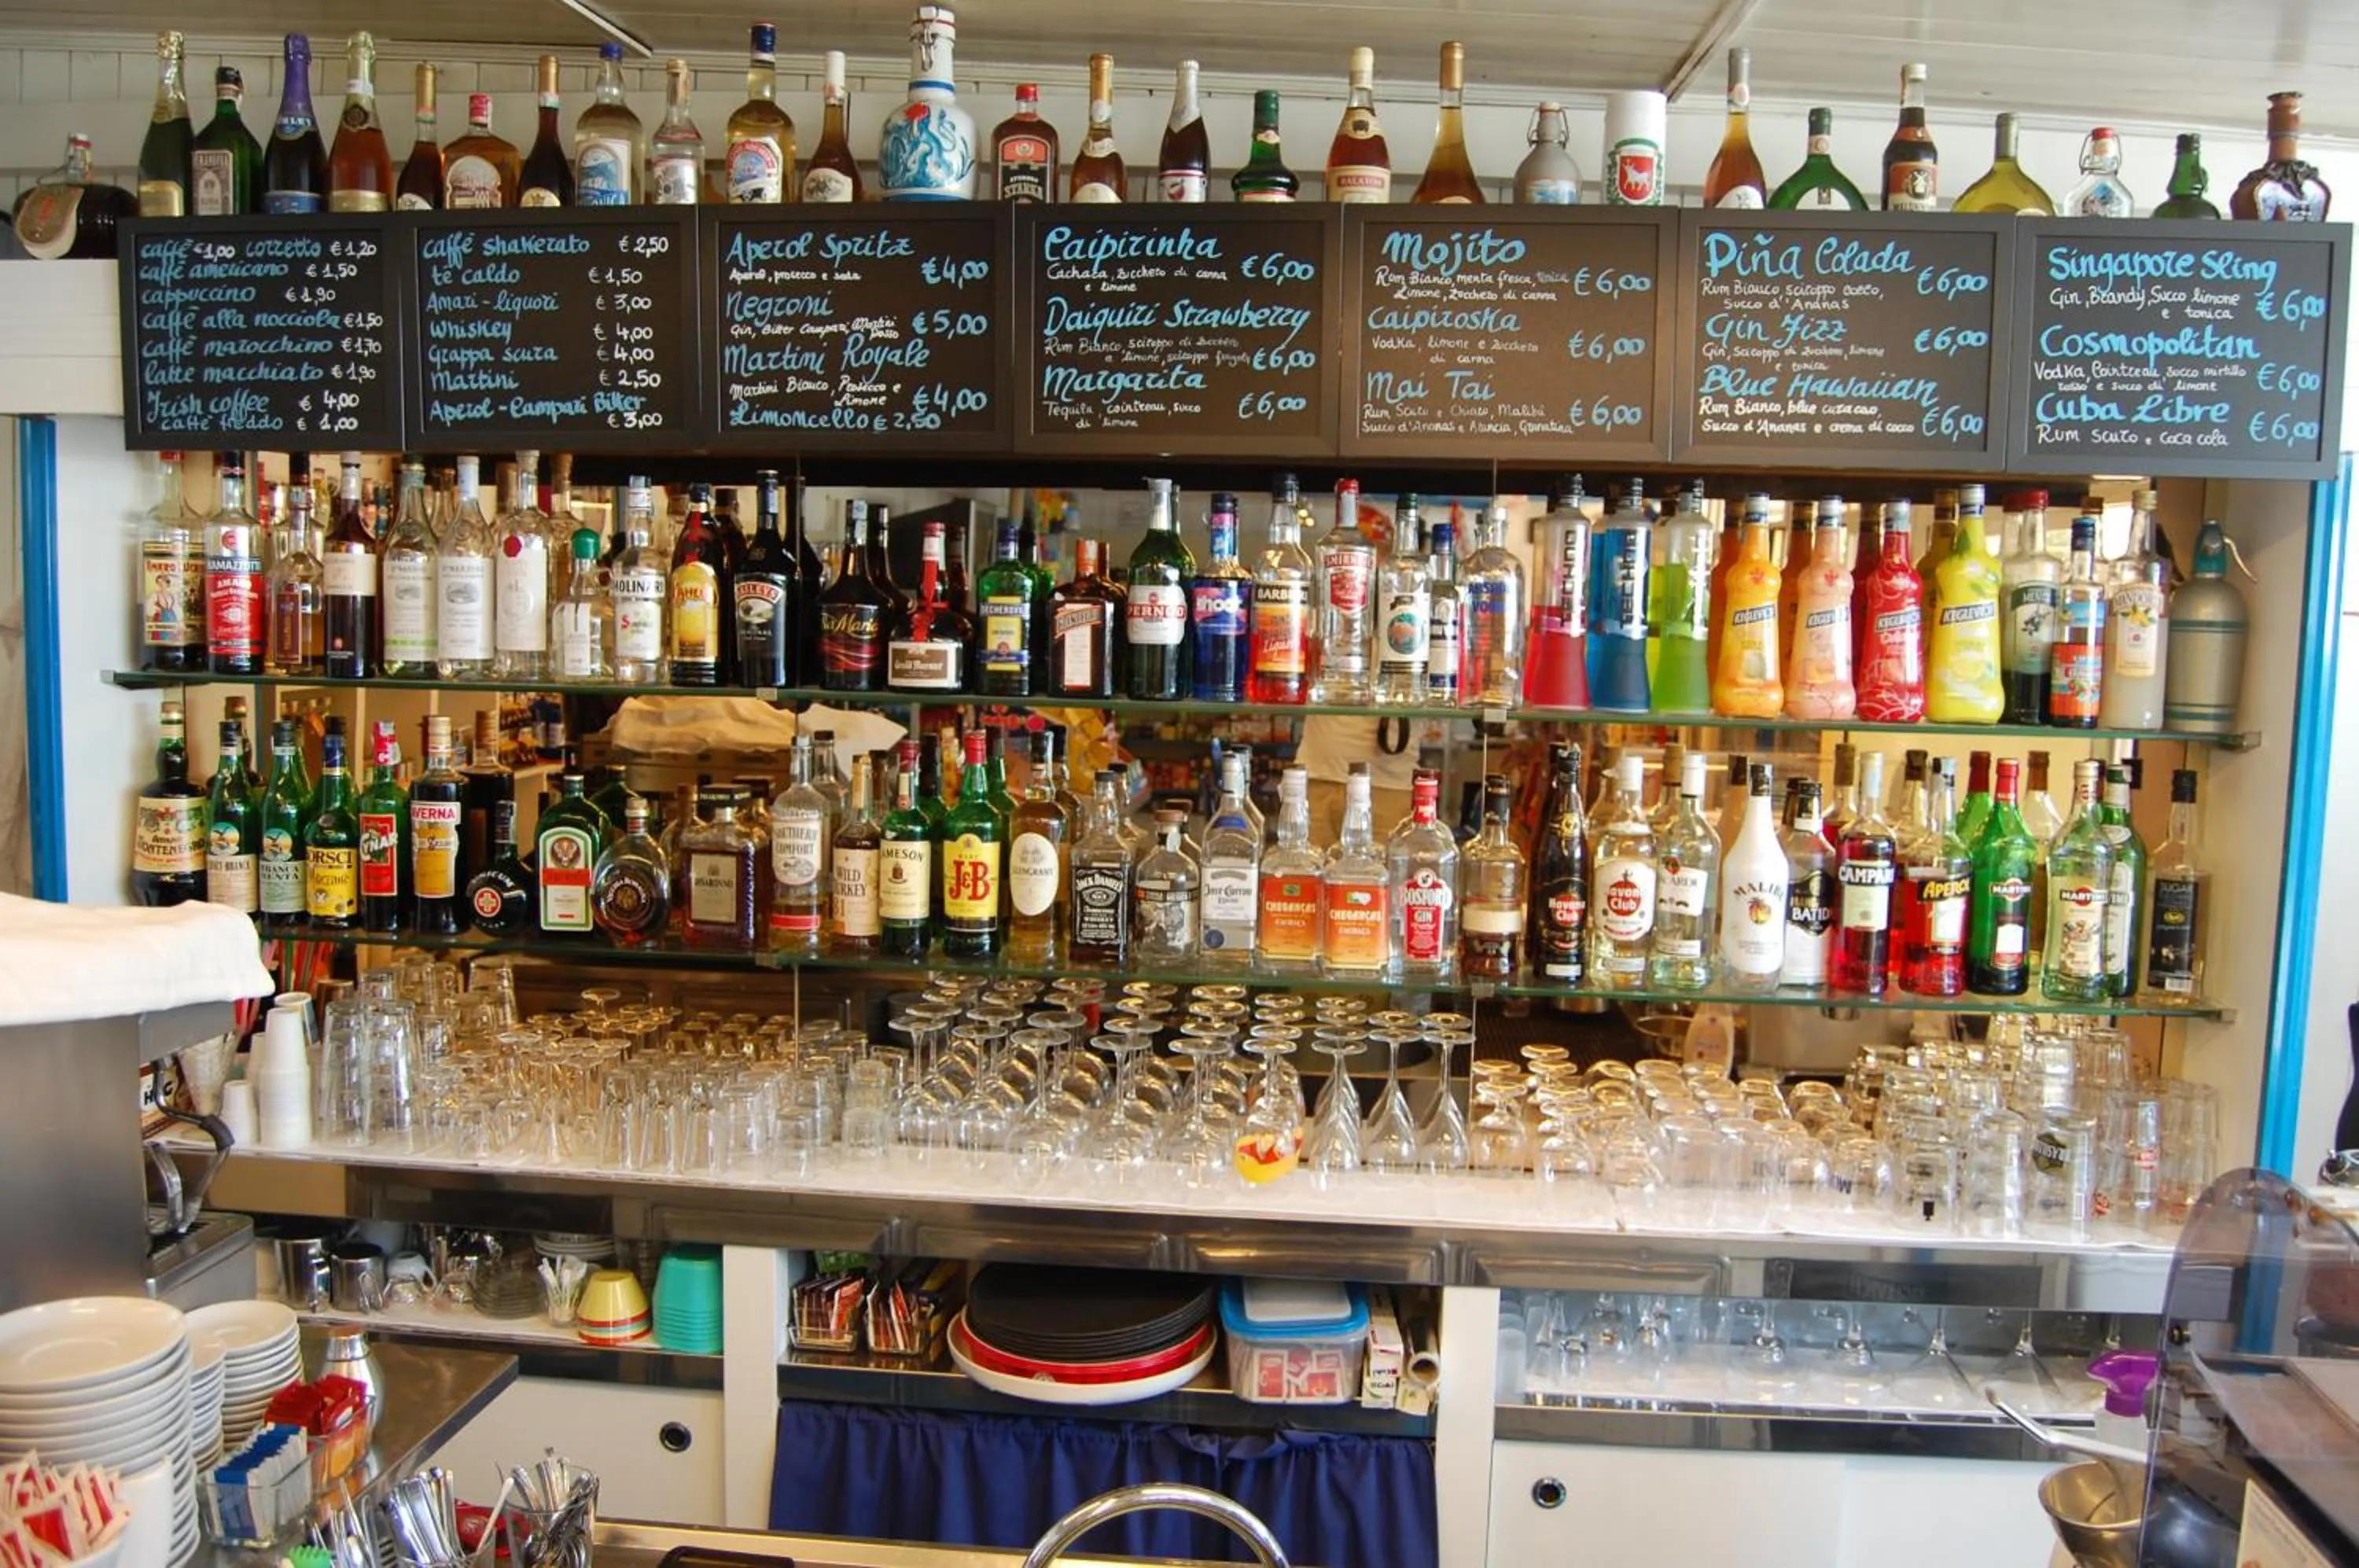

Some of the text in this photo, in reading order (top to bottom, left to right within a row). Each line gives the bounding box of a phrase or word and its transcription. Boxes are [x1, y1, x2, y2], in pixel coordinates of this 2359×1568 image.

[726, 230, 813, 271] Aperol
[1044, 226, 1222, 275] Caipirinha
[1382, 228, 1525, 277] Mojito
[1704, 231, 1804, 279] Piña
[1815, 236, 1916, 274] Colada
[189, 262, 288, 279] americano
[462, 264, 520, 284] caldo
[1375, 265, 1404, 287] Rum
[2048, 247, 2276, 296] Singapore Sling
[142, 285, 256, 310] cappuccino
[1702, 278, 1730, 296] Rum
[2192, 289, 2239, 305] limone
[203, 309, 246, 329] alla
[254, 309, 341, 329] nocciola
[726, 290, 834, 328] Negroni
[1043, 296, 1310, 349] Daiquiri Strawberry
[2184, 307, 2233, 318] tonica
[1706, 313, 1769, 344] Gin
[1772, 313, 1848, 348] Fizz
[429, 345, 494, 371] Grappa
[723, 333, 930, 385] Martini Royale
[1044, 337, 1072, 356] Rum
[2041, 324, 2261, 374] Cosmopolitan
[432, 370, 520, 392] Martini
[1043, 364, 1207, 403] Margarita
[1367, 370, 1496, 403] Mai Tai
[1699, 365, 1938, 407] Blue Hawaiian
[210, 388, 269, 421] coffee
[730, 403, 868, 429] Limoncello
[1363, 404, 1390, 420] Rum
[1699, 396, 1730, 416] Rum
[2036, 393, 2229, 424] Cuba Libre
[2035, 424, 2080, 444] Rum
[2160, 431, 2192, 445] coca
[2196, 429, 2229, 447] cola
[948, 859, 990, 901] J&B
[1610, 897, 1637, 911] Club
